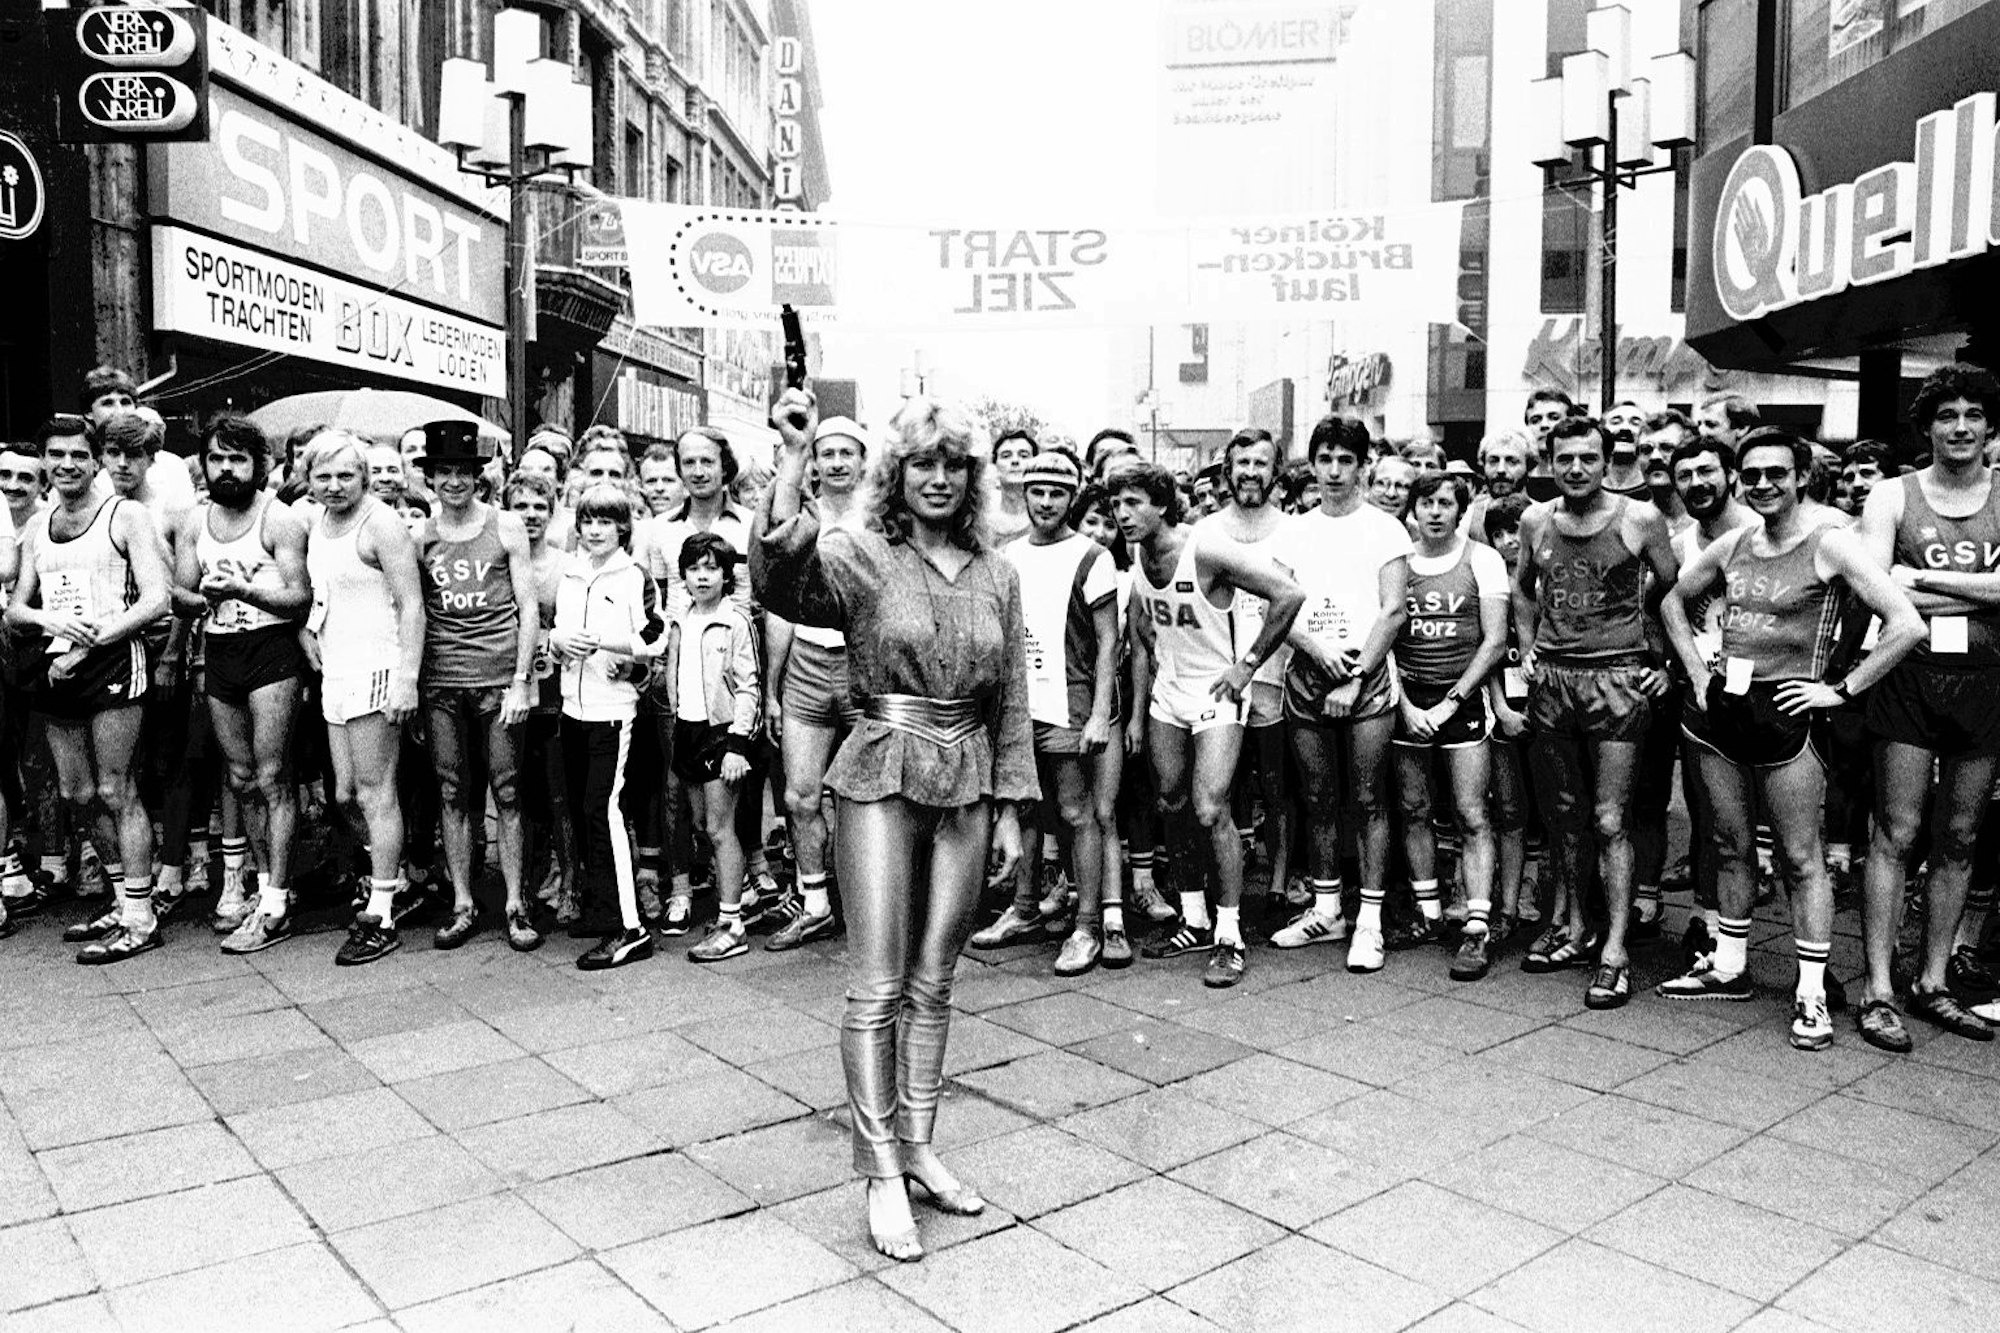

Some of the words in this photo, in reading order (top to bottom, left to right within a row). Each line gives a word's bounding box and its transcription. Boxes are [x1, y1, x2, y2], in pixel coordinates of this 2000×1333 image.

[98, 11, 151, 33] VERA
[101, 77, 153, 99] VERA
[219, 109, 482, 301] SPORT
[1713, 91, 2000, 321] Quell
[186, 246, 325, 313] SPORTMODEN
[206, 291, 312, 343] TRACHTEN
[335, 291, 414, 367] BOX
[421, 320, 502, 361] LEDERMODEN
[438, 354, 487, 384] LODEN
[441, 590, 488, 611] Porz
[1553, 588, 1607, 609] Porz
[1410, 617, 1457, 637] Porz
[1727, 605, 1777, 630] Porz
